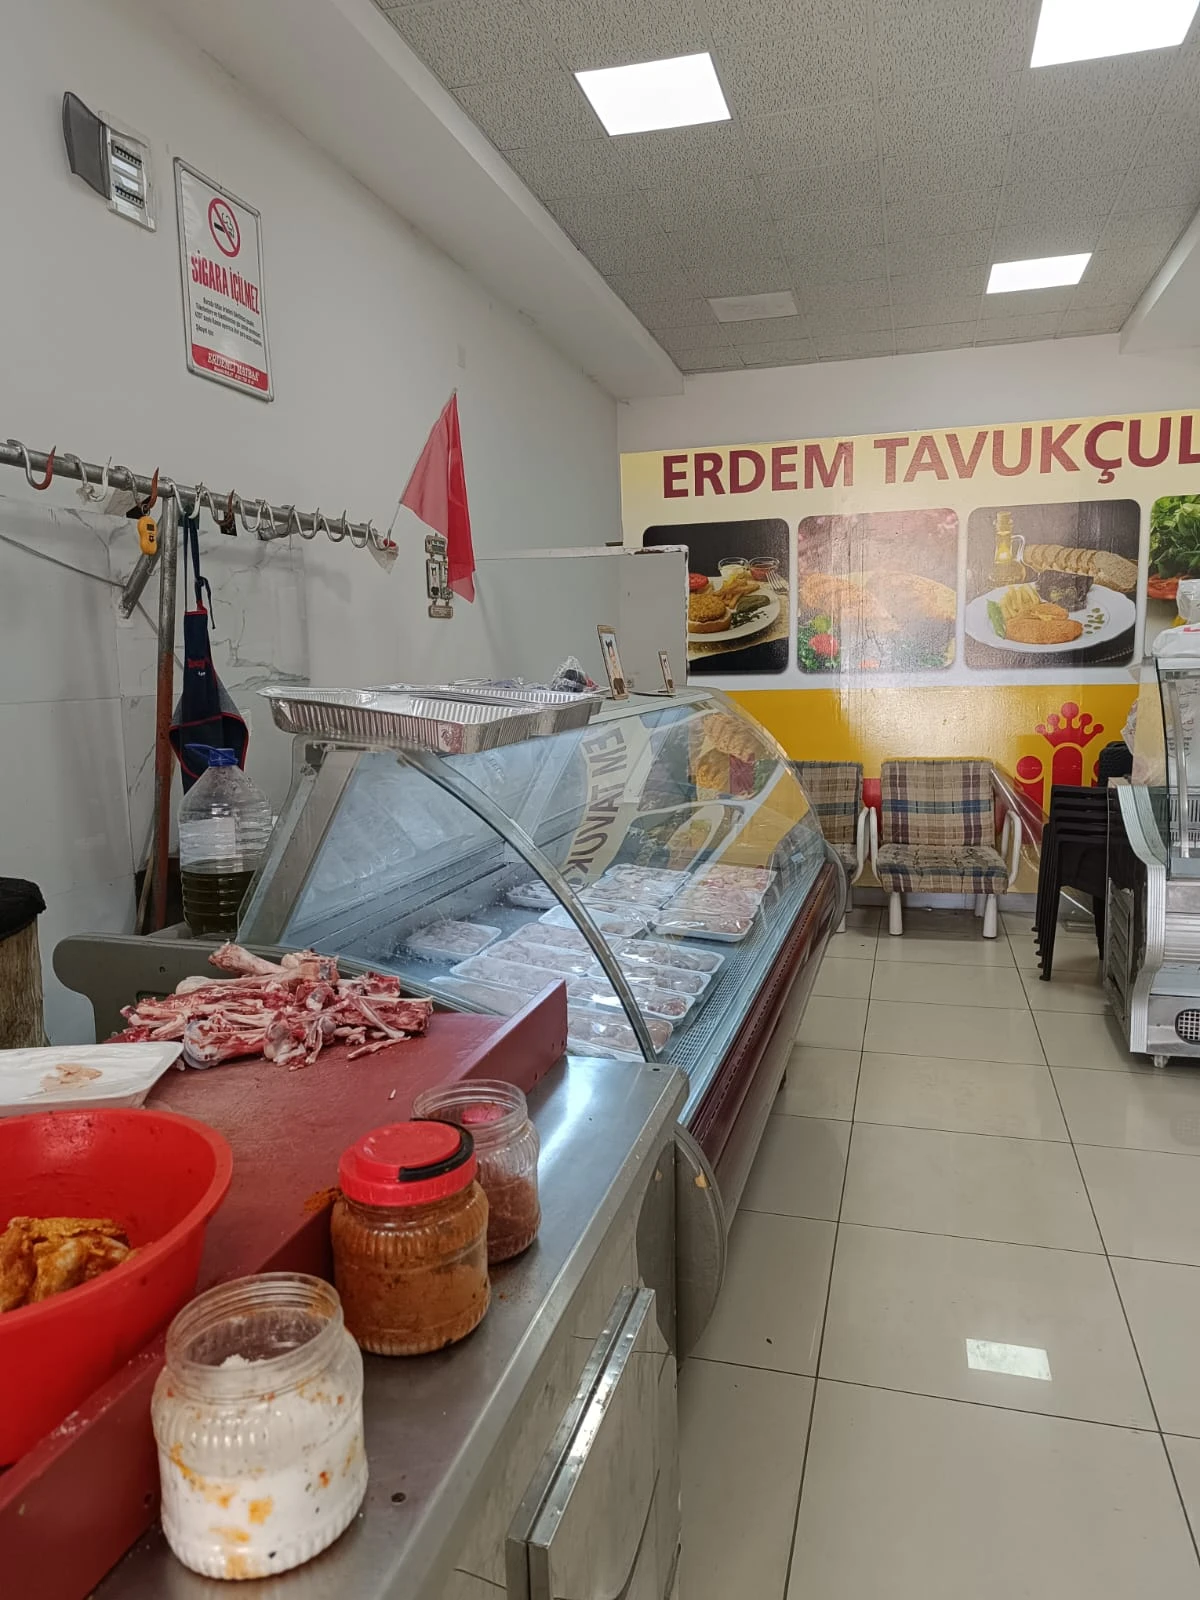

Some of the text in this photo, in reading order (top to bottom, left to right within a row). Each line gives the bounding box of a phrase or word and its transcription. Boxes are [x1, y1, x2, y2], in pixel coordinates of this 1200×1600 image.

[191, 250, 229, 297] SİGARA
[229, 266, 260, 315] İÇİLMEZ
[662, 441, 854, 499] ERDEM
